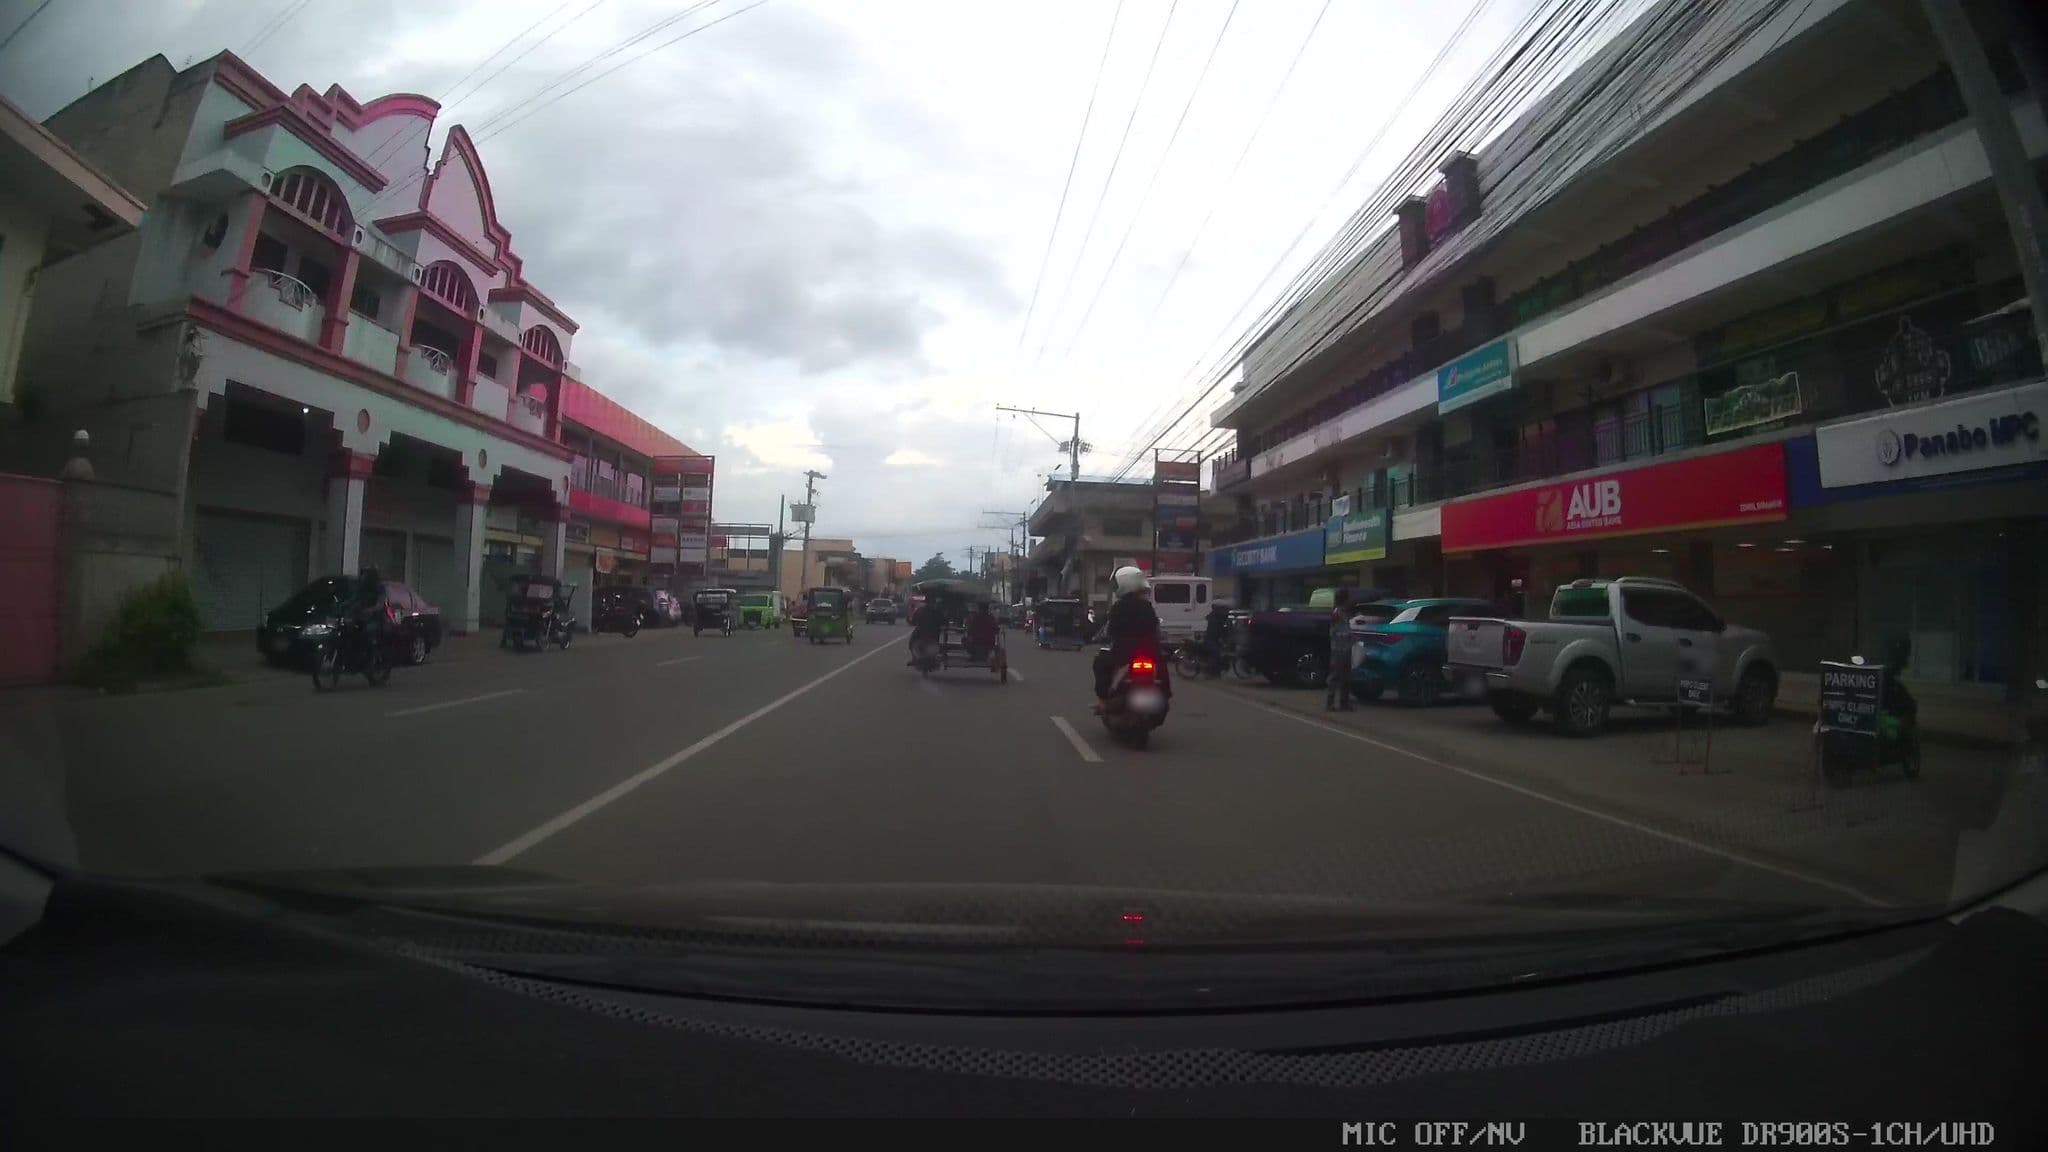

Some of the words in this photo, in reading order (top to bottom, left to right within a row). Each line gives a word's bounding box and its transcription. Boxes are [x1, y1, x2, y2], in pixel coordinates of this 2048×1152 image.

[1904, 424, 1986, 459] Panabo
[1566, 480, 1621, 520] AUB
[1824, 672, 1876, 688] PARKING
